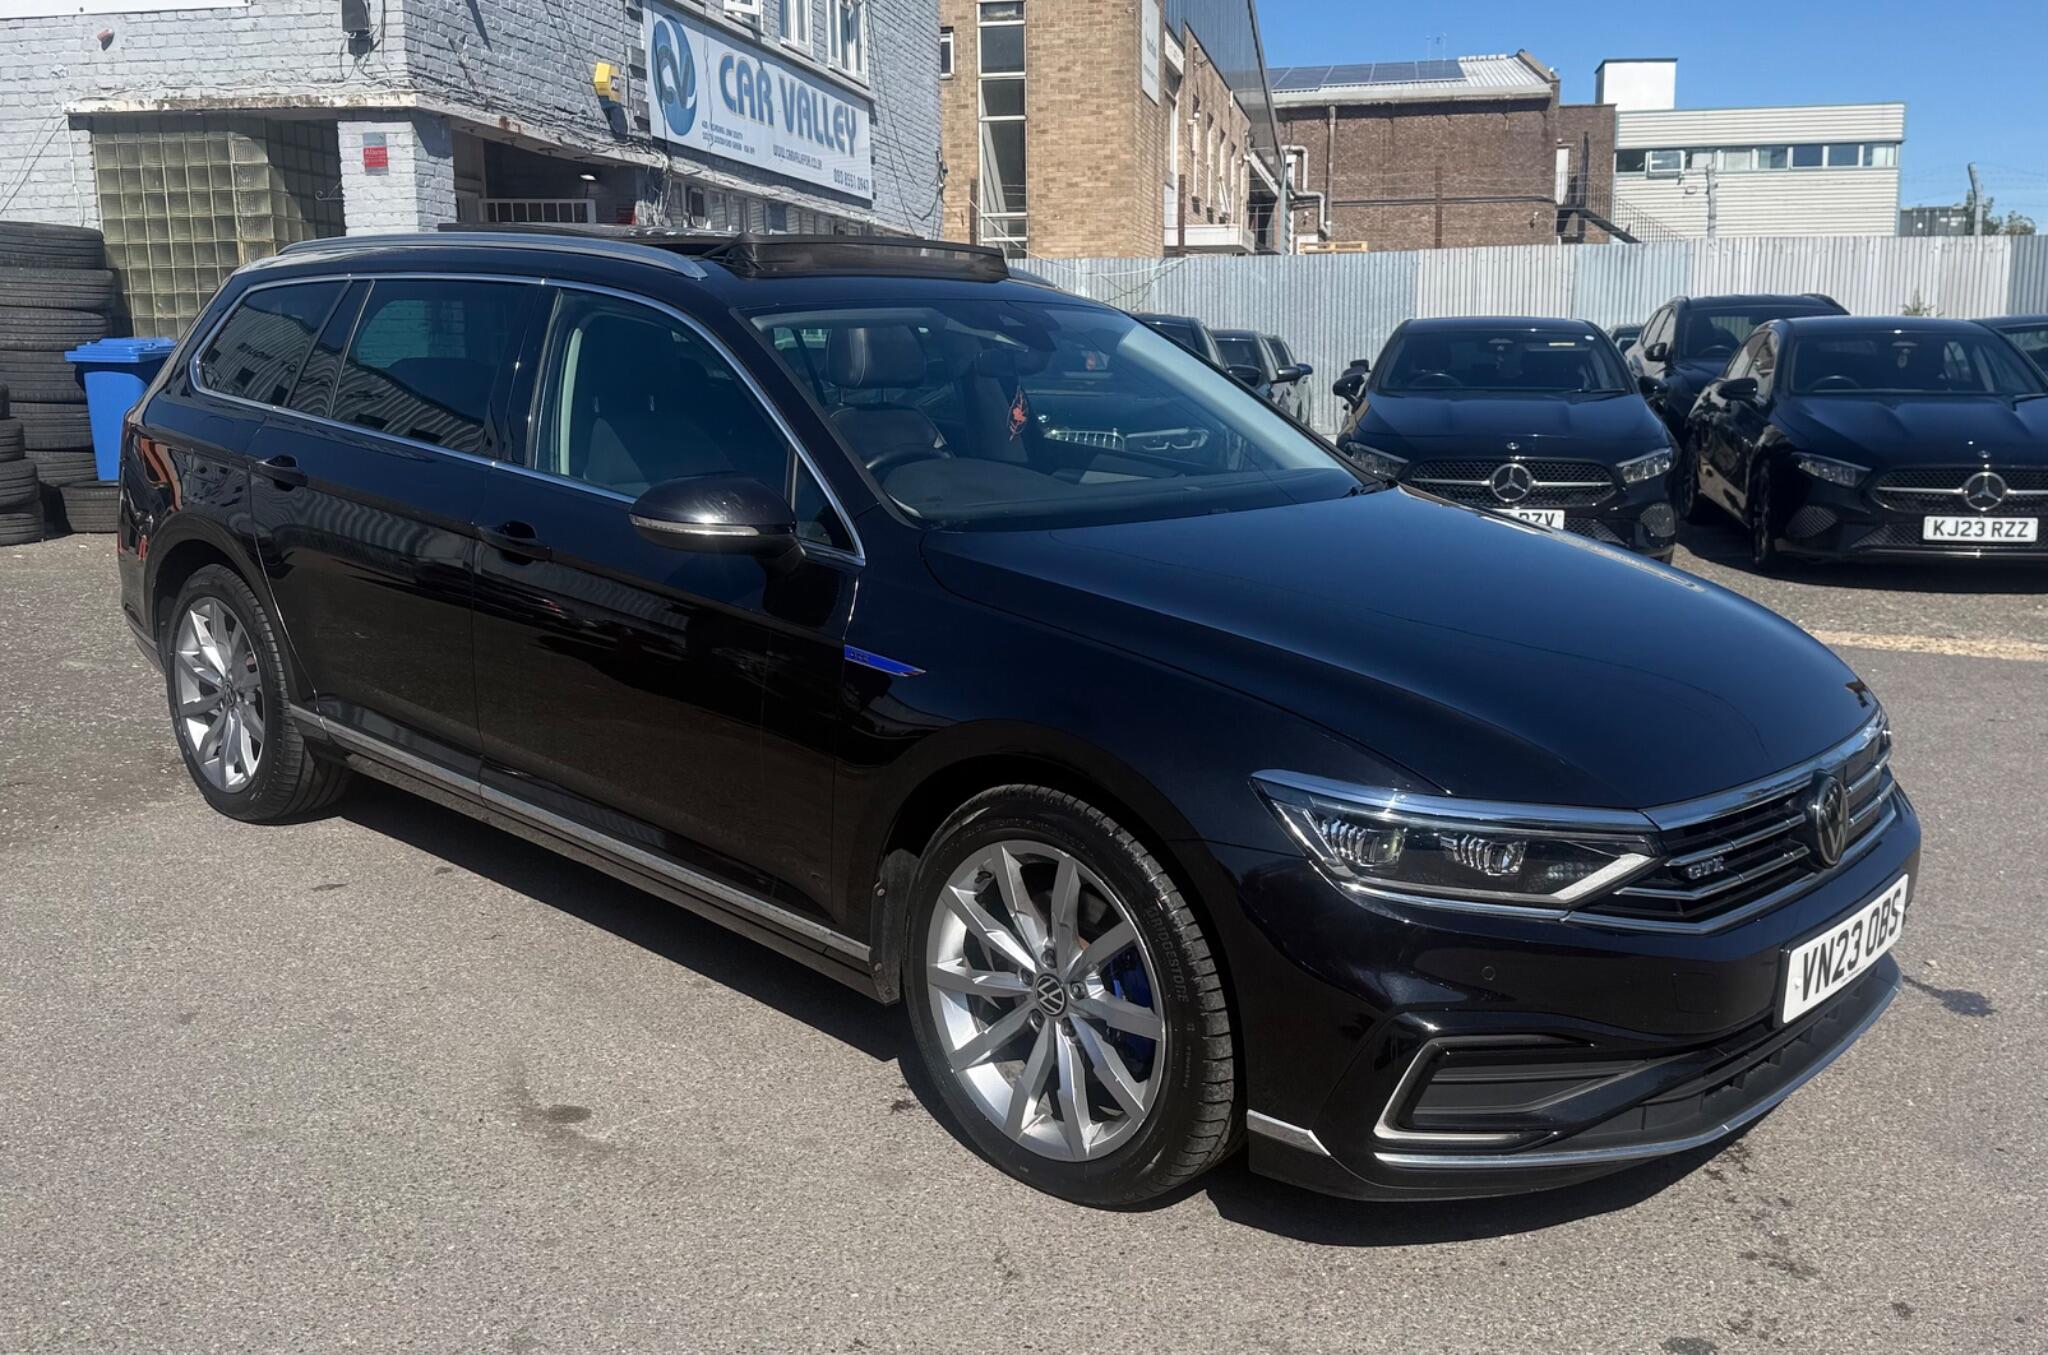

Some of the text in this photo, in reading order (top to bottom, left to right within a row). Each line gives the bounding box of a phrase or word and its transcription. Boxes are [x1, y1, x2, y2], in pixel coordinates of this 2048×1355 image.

[719, 54, 857, 158] CAR VALLEY
[1933, 519, 2029, 538] KJ23 RZZ
[1688, 855, 1725, 880] GTE
[1147, 903, 1190, 1003] BRIDGESTONE
[1802, 888, 1902, 1001] VN23 OBS
